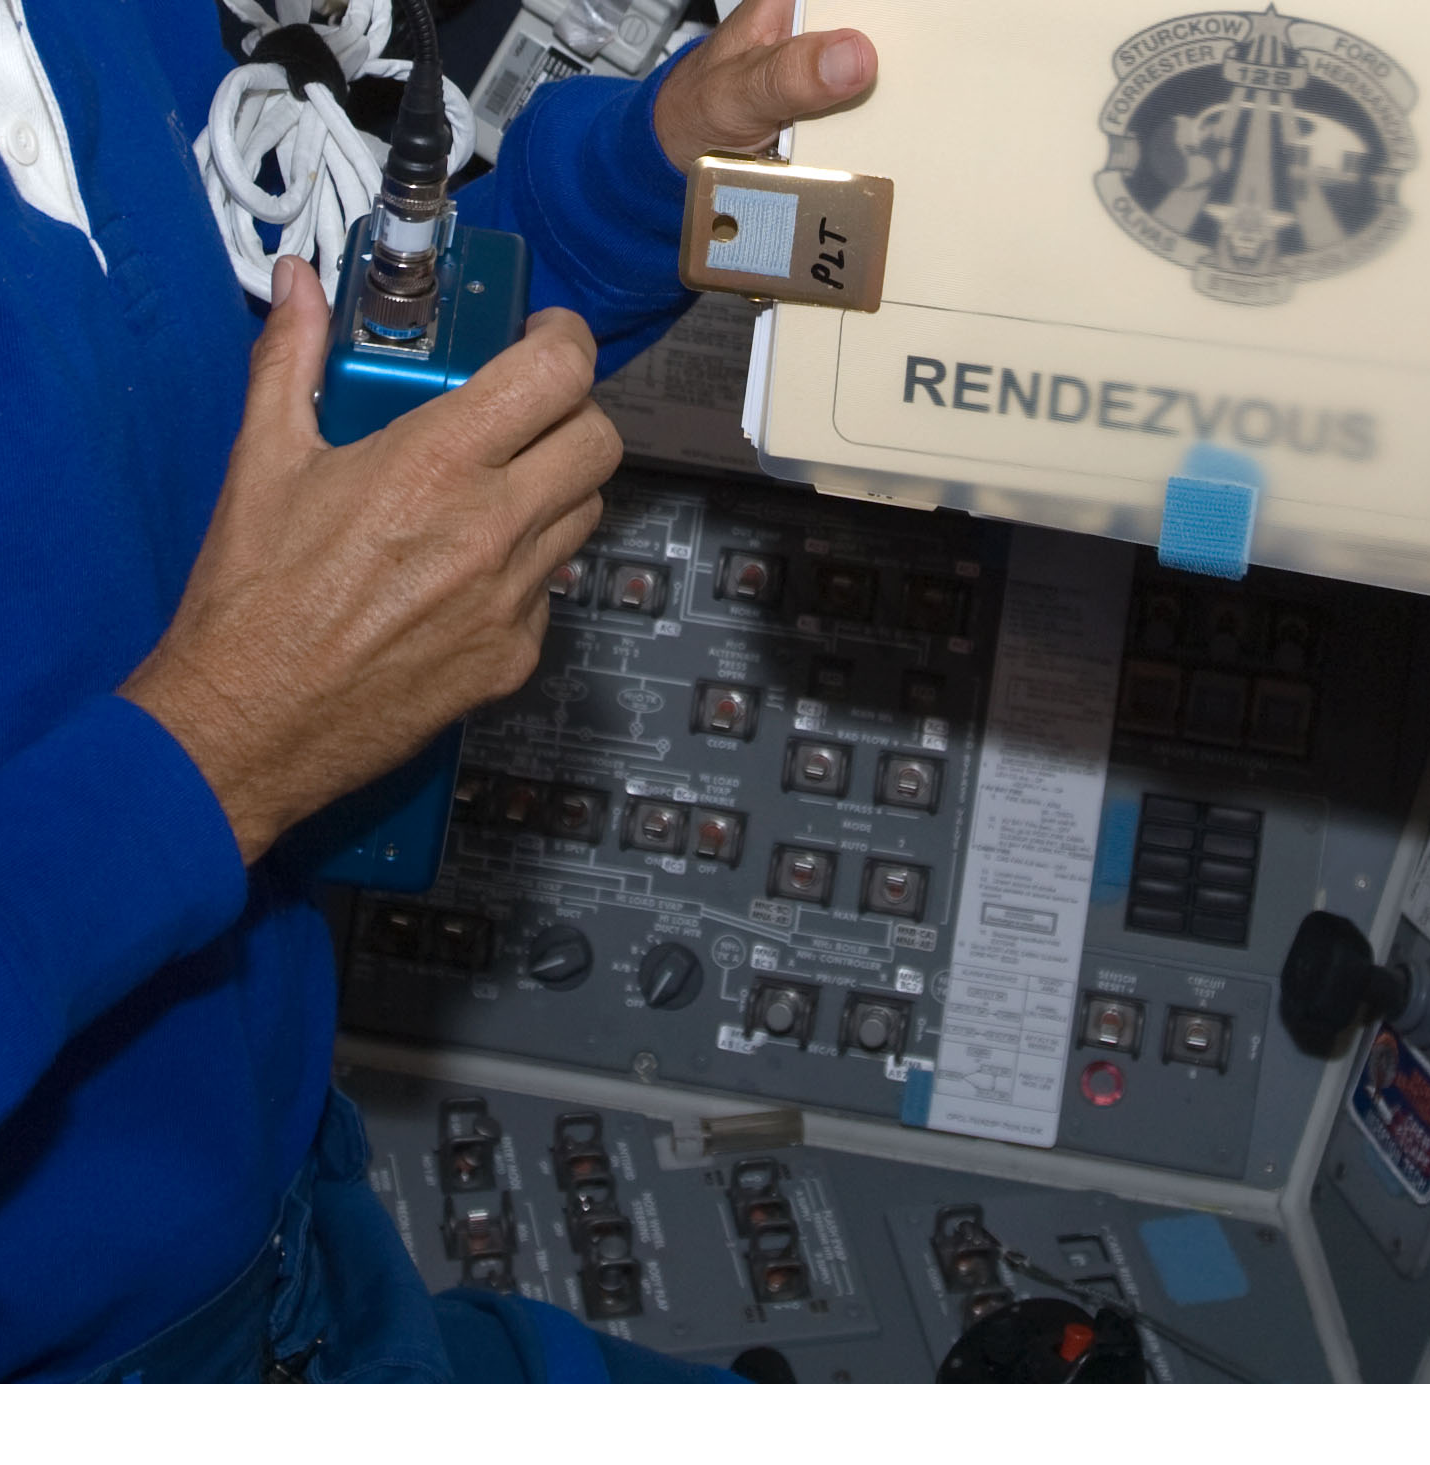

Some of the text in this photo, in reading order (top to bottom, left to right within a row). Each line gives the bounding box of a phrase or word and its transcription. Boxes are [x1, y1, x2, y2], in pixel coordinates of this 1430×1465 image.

[1119, 17, 1244, 68] STURCKOW
[1333, 36, 1392, 79] FORD
[1106, 44, 1216, 125] FORRESTER
[1238, 65, 1292, 85] 128
[1112, 195, 1181, 254] OLIVAS
[810, 217, 849, 290] PLT
[903, 354, 1378, 461] RENDEZVOUS
[841, 841, 869, 853] AUTO
[625, 998, 645, 1009] OFF
